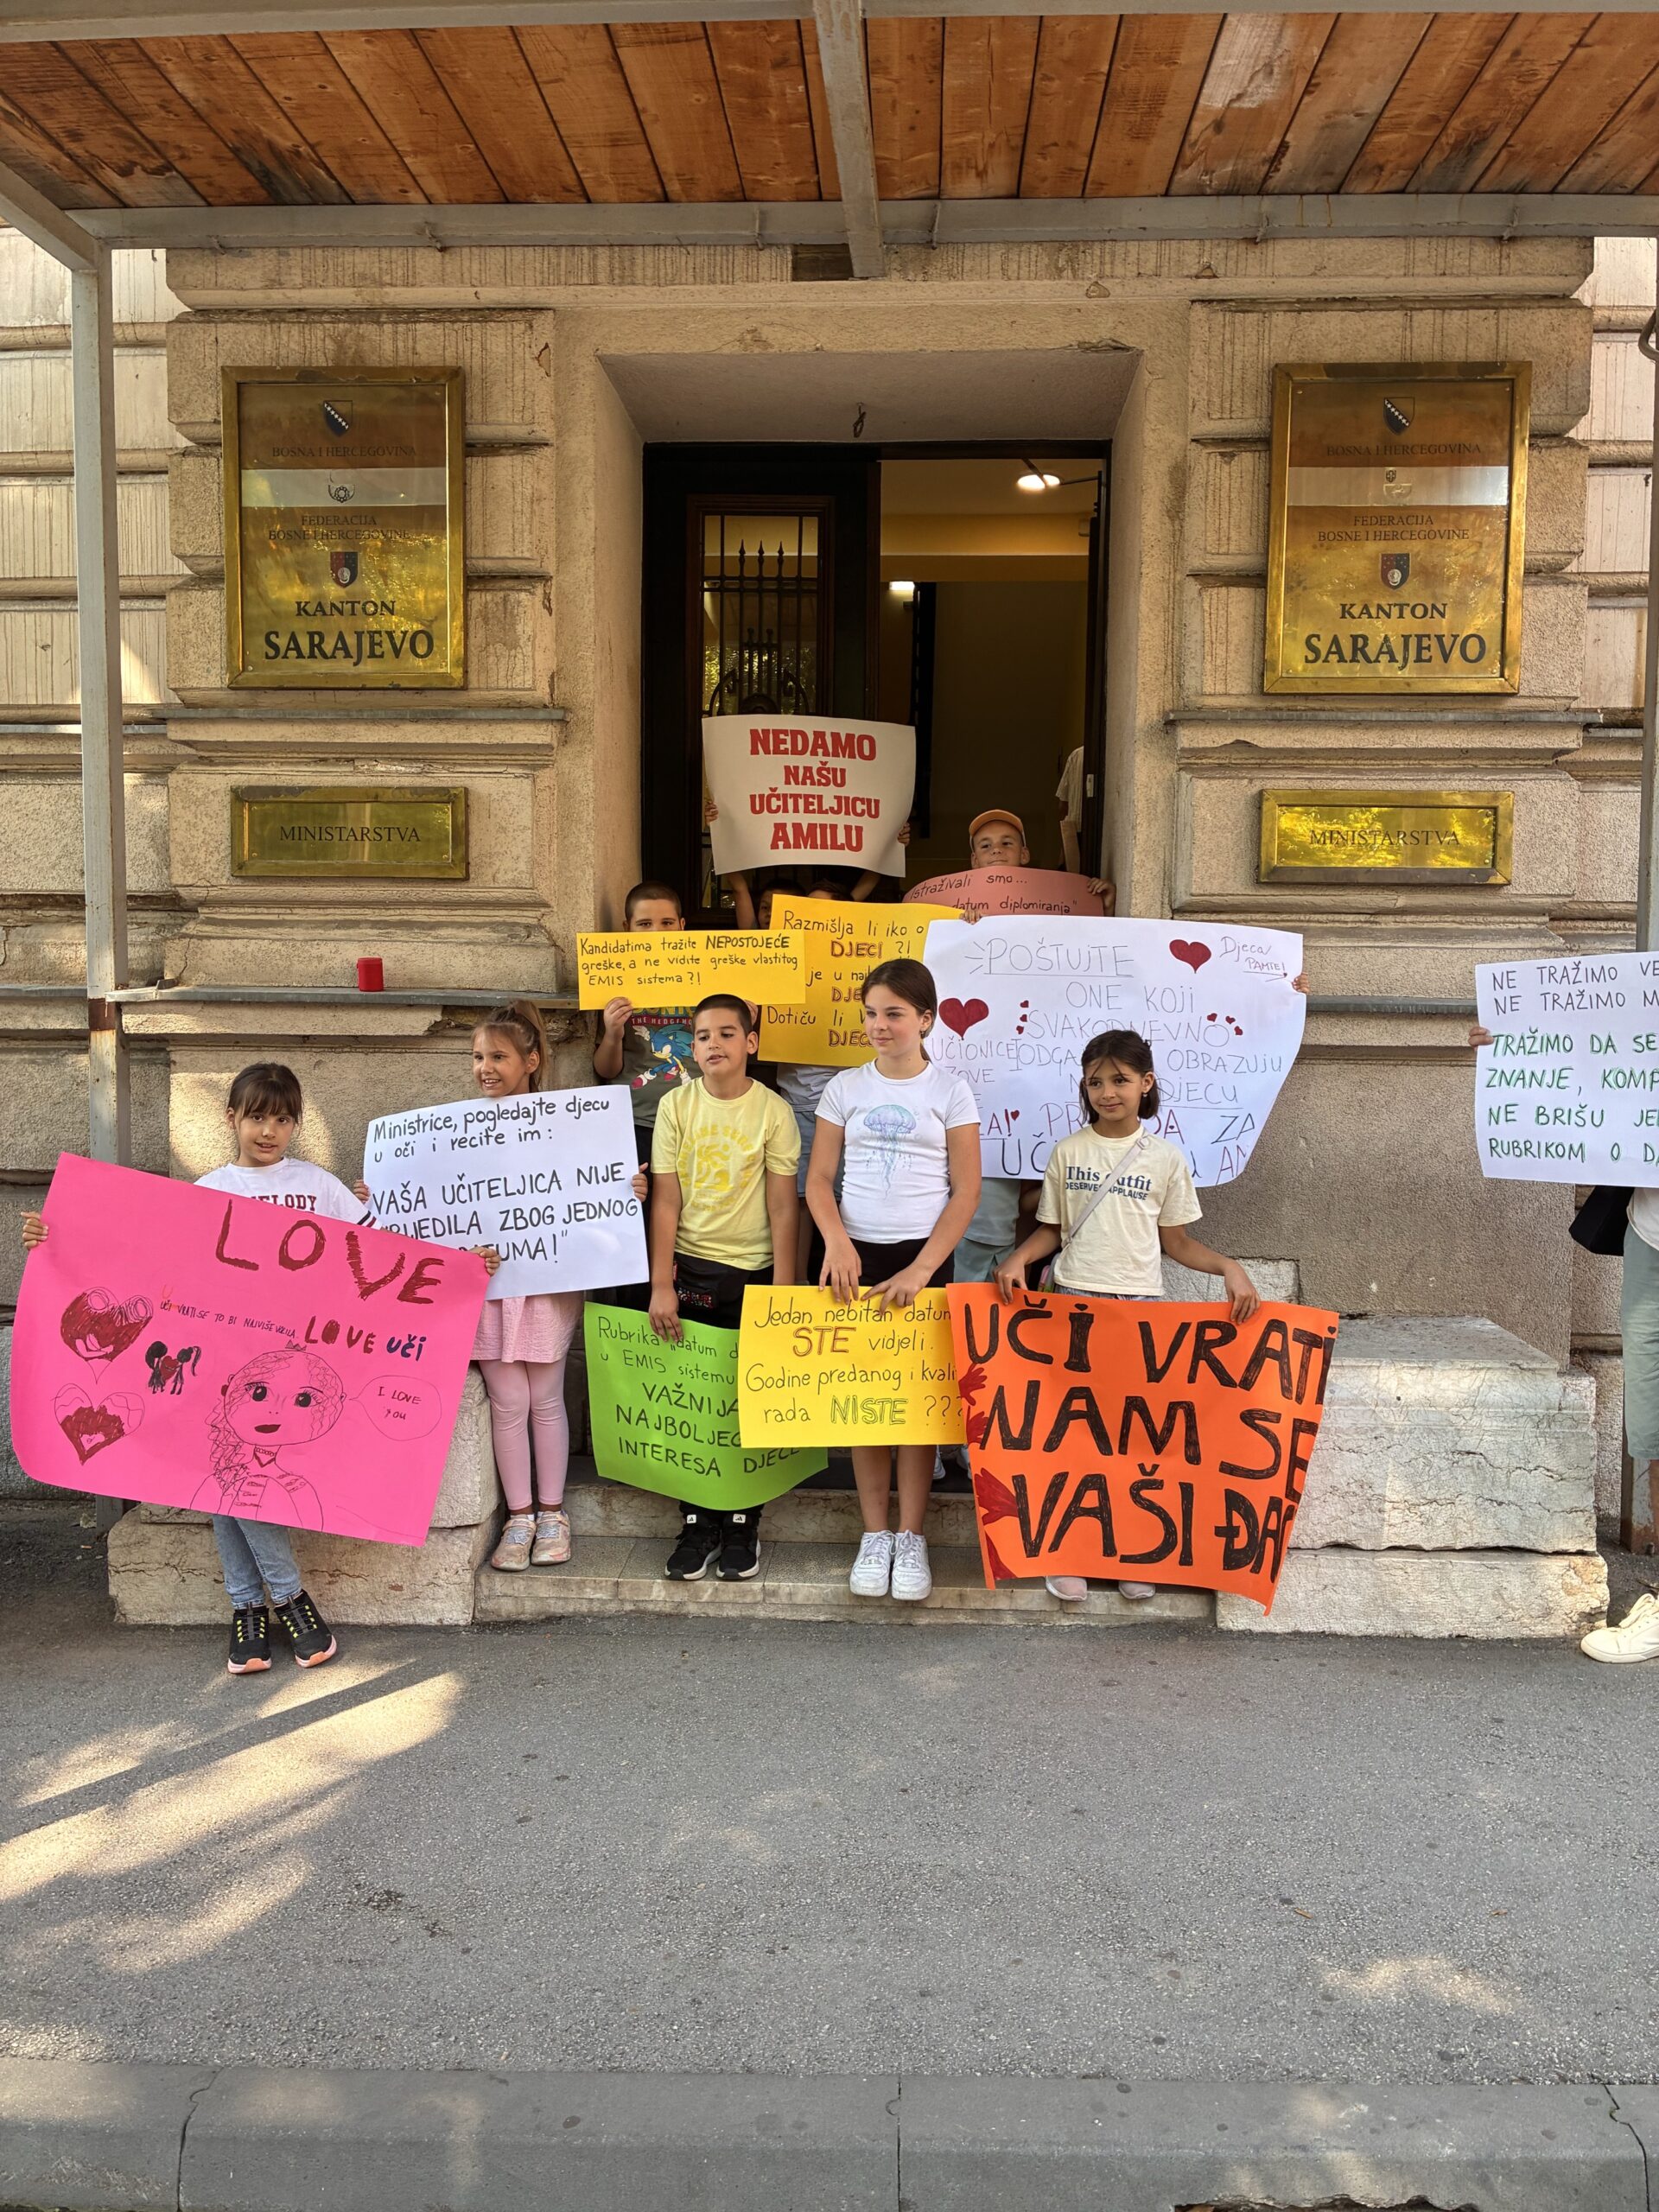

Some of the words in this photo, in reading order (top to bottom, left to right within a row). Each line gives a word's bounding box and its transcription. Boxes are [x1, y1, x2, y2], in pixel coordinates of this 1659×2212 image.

[272, 446, 315, 458] BOSNA
[326, 446, 416, 458] HERCEGOVINA
[1326, 445, 1372, 457] BOSNA
[1382, 443, 1482, 456] HERCEGOVINA
[268, 530, 313, 541] BOSNE
[321, 530, 411, 541] HERCEGOVINE
[301, 515, 378, 527] FEDERACIJA
[1318, 531, 1363, 542] BOSNE
[1373, 528, 1470, 541] HERCEGOVINE
[1353, 515, 1434, 527] FEDERACIJA
[296, 601, 397, 617] KANTON
[1339, 602, 1447, 620] KANTON
[264, 629, 435, 666] SARAJEVO
[1305, 633, 1487, 671] SARAJEVO
[749, 728, 877, 761] NEDAMO
[784, 760, 847, 788] NAŠU
[749, 787, 880, 819] UČITELJICU
[279, 825, 422, 843] MINISTARSTVA
[770, 822, 864, 852] AMILU
[1309, 830, 1460, 846] MINISTARSTVA
[783, 910, 854, 939] Razmišlja
[868, 920, 879, 937] li
[886, 925, 907, 938] iko
[580, 938, 652, 957] Kandidatima
[661, 936, 696, 950] tražite
[705, 933, 791, 950] NEPOSTOJEĆE
[830, 940, 883, 959] DJECI
[582, 957, 626, 976] greške,
[628, 959, 637, 969] a
[645, 957, 660, 967] ne
[667, 954, 701, 966] vidite
[710, 954, 747, 969] greške
[753, 952, 798, 970] vlastitog
[834, 971, 842, 981] u
[1492, 970, 1518, 992] NE
[1536, 960, 1618, 986] TRAŽIMO
[1639, 960, 1659, 976] VE
[588, 974, 623, 987] EMIS
[637, 971, 683, 985] sistema
[1065, 981, 1125, 1012] ONE
[1494, 995, 1523, 1015] NE
[1540, 989, 1626, 1011] TRAŽIMO
[767, 1005, 817, 1026] Dotiču
[834, 1008, 844, 1027] li
[1492, 1025, 1574, 1058] TRAŽIMO
[1589, 1032, 1618, 1055] DA
[1601, 1068, 1659, 1092] KOMP
[373, 1113, 459, 1143] Ministrice,
[463, 1096, 556, 1134] pogledajte
[565, 1095, 610, 1120] djecu
[1488, 1103, 1520, 1127] NE
[1535, 1103, 1605, 1128] BRIŠU
[374, 1150, 383, 1163] u
[394, 1140, 415, 1159] oči
[450, 1128, 505, 1151] recite
[1489, 1137, 1586, 1163] RUBRIKOM
[372, 1180, 428, 1216] VAŠA
[442, 1168, 562, 1205] UČITELJICA
[576, 1161, 626, 1187] NIJE
[1065, 1166, 1101, 1182] This
[1105, 1172, 1153, 1192] utfit
[499, 1205, 556, 1232] ZBOG
[562, 1198, 639, 1225] JEDNOG
[215, 1199, 445, 1304] LOVE
[754, 1296, 813, 1328] Jedan
[824, 1298, 893, 1324] nebitan
[304, 1315, 377, 1354] LOVE
[598, 1316, 660, 1346] Rubrika
[791, 1326, 856, 1357] STE
[601, 1353, 609, 1362] u
[622, 1350, 667, 1374] EMIS
[677, 1363, 735, 1386] sistemu
[746, 1363, 810, 1392] Godine
[817, 1363, 901, 1395] predanog
[921, 1359, 957, 1382] kvali
[378, 1386, 386, 1397] I
[391, 1389, 423, 1405] LOVE
[764, 1396, 811, 1424] rada
[830, 1395, 909, 1426] NISTE
[616, 1404, 741, 1448] NAJBOLJEG
[979, 1380, 1202, 1465] NAM
[1218, 1408, 1319, 1503] SE
[618, 1437, 721, 1478] INTERESA
[1012, 1463, 1195, 1567] VAŠI
